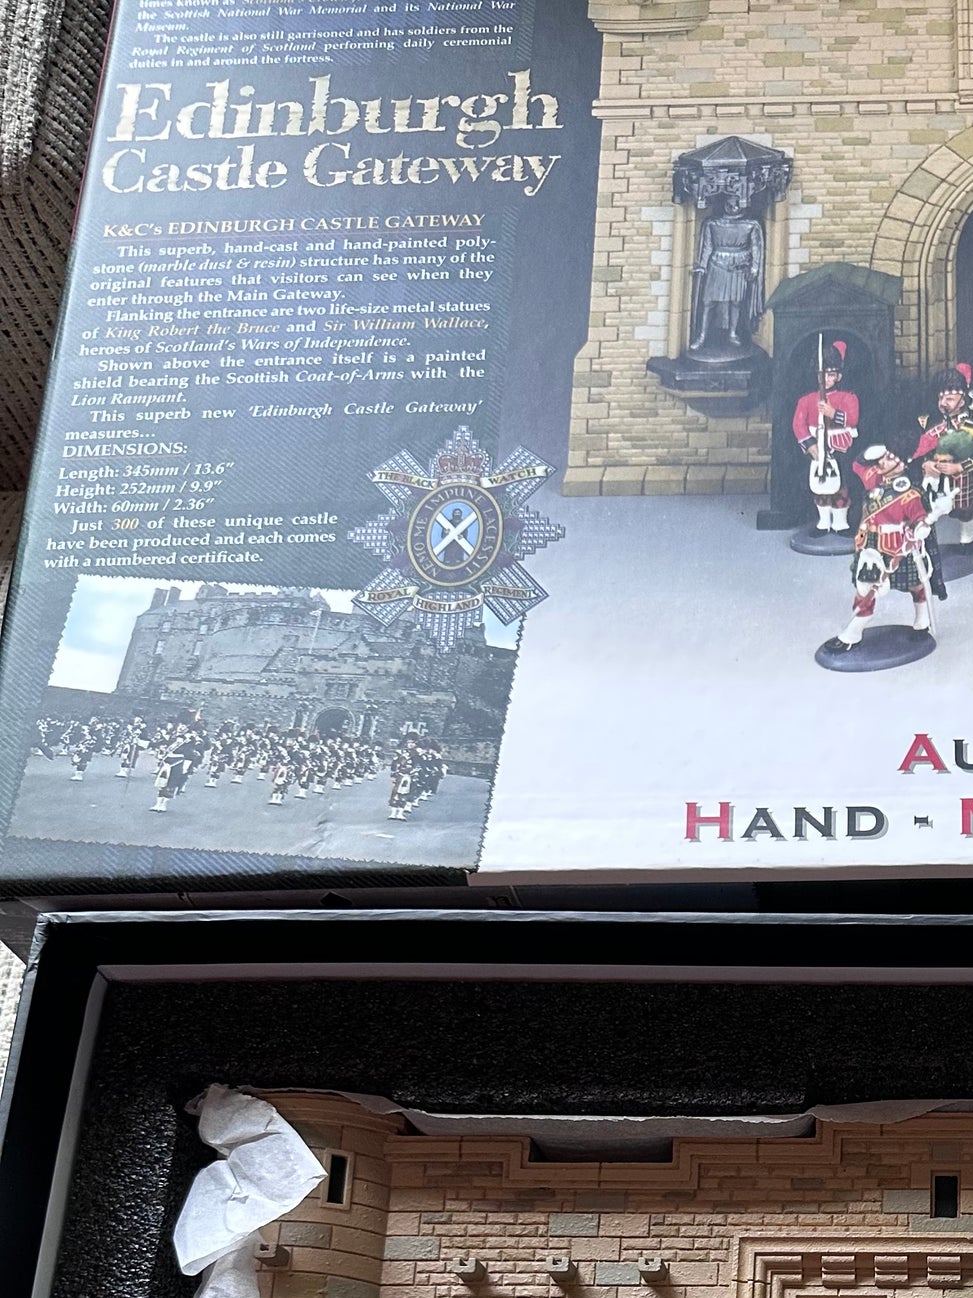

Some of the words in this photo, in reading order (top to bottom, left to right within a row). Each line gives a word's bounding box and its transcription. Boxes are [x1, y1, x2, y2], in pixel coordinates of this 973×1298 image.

[138, 9, 156, 19] the
[164, 8, 210, 18] Scottish
[218, 6, 270, 17] National
[278, 5, 304, 15] War
[308, 3, 368, 14] Memorial
[374, 2, 396, 12] and
[404, 2, 420, 11] its
[428, 0, 482, 11] National
[492, 0, 516, 9] War
[154, 33, 178, 43] The
[180, 32, 216, 42] castle
[218, 31, 228, 41] is
[232, 31, 256, 40] also
[260, 29, 284, 40] still
[288, 27, 354, 42] garrisoned
[356, 27, 380, 37] and
[384, 26, 404, 36] has
[408, 25, 456, 35] soldiers
[460, 24, 490, 34] from
[494, 23, 514, 33] the
[132, 45, 168, 58] Royal
[176, 44, 234, 57] Regiment
[242, 42, 256, 52] of
[262, 41, 316, 52] Scotland
[324, 39, 394, 53] performing
[404, 37, 434, 50] daily
[444, 35, 512, 46] ceremonial
[107, 69, 564, 149] Edinburgh
[102, 144, 287, 193] Castle
[303, 142, 561, 196] Gateway
[168, 218, 294, 234] EDINBURGH
[300, 216, 380, 230] CASTLE
[384, 213, 486, 228] GATEWAY
[118, 245, 150, 257] This
[158, 243, 216, 258] superb,
[224, 241, 298, 254] hand-cast
[306, 239, 336, 251] and
[344, 236, 448, 251] hand-painted
[456, 235, 496, 249] poly-
[92, 263, 134, 274] stone
[138, 259, 196, 275] (marble
[198, 259, 232, 270] dust
[236, 257, 250, 269] &
[254, 256, 296, 270] resin)
[300, 256, 368, 268] structure
[372, 254, 398, 265] has
[402, 256, 446, 266] many
[450, 251, 466, 263] of
[470, 251, 494, 263] the
[87, 276, 152, 291] original
[160, 276, 222, 288] features
[232, 274, 260, 285] that
[270, 272, 328, 284] visitors
[336, 274, 362, 282] can
[372, 273, 398, 281] see
[406, 268, 450, 280] when
[460, 267, 494, 281] they
[86, 294, 128, 306] enter
[132, 291, 192, 306] through
[198, 290, 222, 302] the
[228, 289, 268, 302] Main
[272, 289, 346, 301] Gateway.
[106, 308, 174, 323] Flanking
[176, 307, 200, 320] the
[204, 307, 268, 319] entrance
[270, 308, 294, 317] are
[298, 305, 326, 316] two
[330, 302, 390, 315] life-size
[392, 300, 434, 313] metal
[438, 300, 490, 312] statues
[82, 326, 100, 339] of
[106, 326, 140, 340] King
[148, 324, 200, 337] Robert
[206, 323, 230, 335] the
[236, 322, 280, 334] Bruce
[286, 320, 316, 333] and
[324, 319, 346, 332] Sir
[354, 318, 416, 331] William
[424, 316, 488, 330] Wallace,
[78, 343, 130, 355] heroes
[134, 341, 152, 354] of
[242, 338, 280, 351] Wars
[284, 337, 302, 349] of
[304, 335, 410, 351] Independence.
[98, 359, 152, 371] Shown
[162, 357, 210, 369] above
[220, 355, 244, 368] the
[254, 355, 320, 367] entrance
[332, 351, 374, 365] itself
[384, 351, 396, 363] is
[406, 354, 414, 362] a
[426, 348, 486, 364] painted
[74, 376, 122, 389] shield
[128, 374, 190, 389] bearing
[196, 373, 220, 386] the
[226, 371, 288, 385] Scottish
[296, 368, 404, 383] Coat-of-Arms
[410, 366, 446, 379] with
[460, 365, 484, 378] the
[72, 394, 106, 406] Lion
[110, 392, 186, 407] Rampant.
[90, 409, 124, 422] This
[136, 407, 190, 423] superb
[202, 409, 236, 419] new
[344, 402, 394, 415] Castle
[62, 441, 188, 457] DIMENSIONS:
[58, 465, 120, 481] Length:
[122, 464, 178, 478] 345mm
[377, 471, 400, 482] THE
[402, 473, 436, 489] BLACK
[488, 469, 537, 485] WATCH
[56, 483, 116, 499] Height:
[120, 481, 176, 495] 252mm
[54, 500, 108, 514] Width:
[112, 499, 158, 512] 60mm
[72, 519, 102, 535] Just
[112, 517, 140, 530] 300
[146, 516, 166, 529] of
[174, 516, 216, 529] these
[224, 514, 284, 529] unique
[292, 512, 338, 525] castle
[46, 537, 84, 550] have
[88, 536, 128, 549] been
[132, 533, 210, 551] produced
[214, 532, 244, 545] and
[248, 531, 282, 545] each
[286, 533, 336, 543] comes
[44, 554, 78, 568] with
[82, 558, 92, 567] a
[96, 552, 176, 567] numbered
[180, 550, 264, 564] certificate.
[367, 588, 411, 601] ROYAL
[483, 586, 533, 598] REGIMENT
[415, 598, 480, 612] HIGHLAND
[686, 801, 888, 841] HAND
